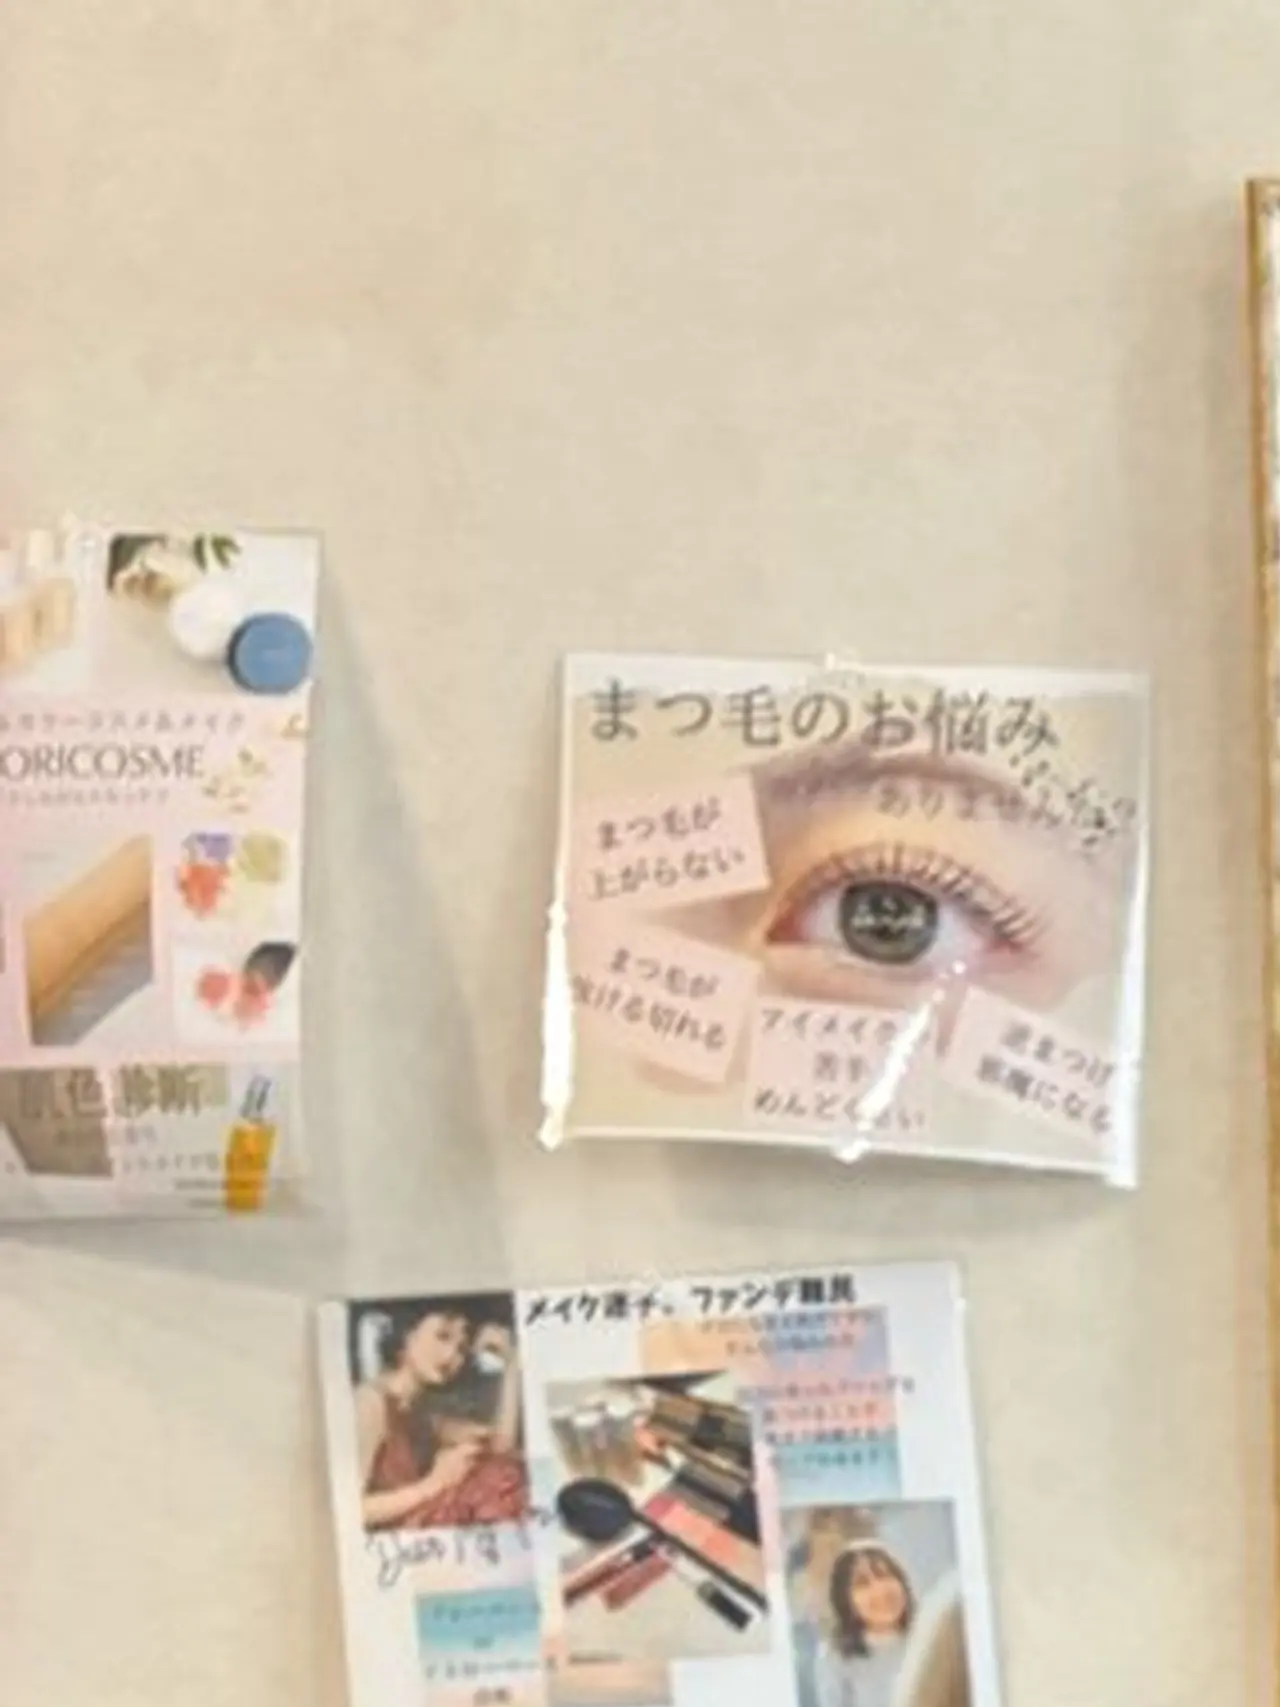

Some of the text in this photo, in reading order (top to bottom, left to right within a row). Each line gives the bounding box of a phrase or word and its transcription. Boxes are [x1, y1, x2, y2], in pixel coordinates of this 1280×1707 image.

[590, 681, 1060, 756] まつ毛のお悩み
